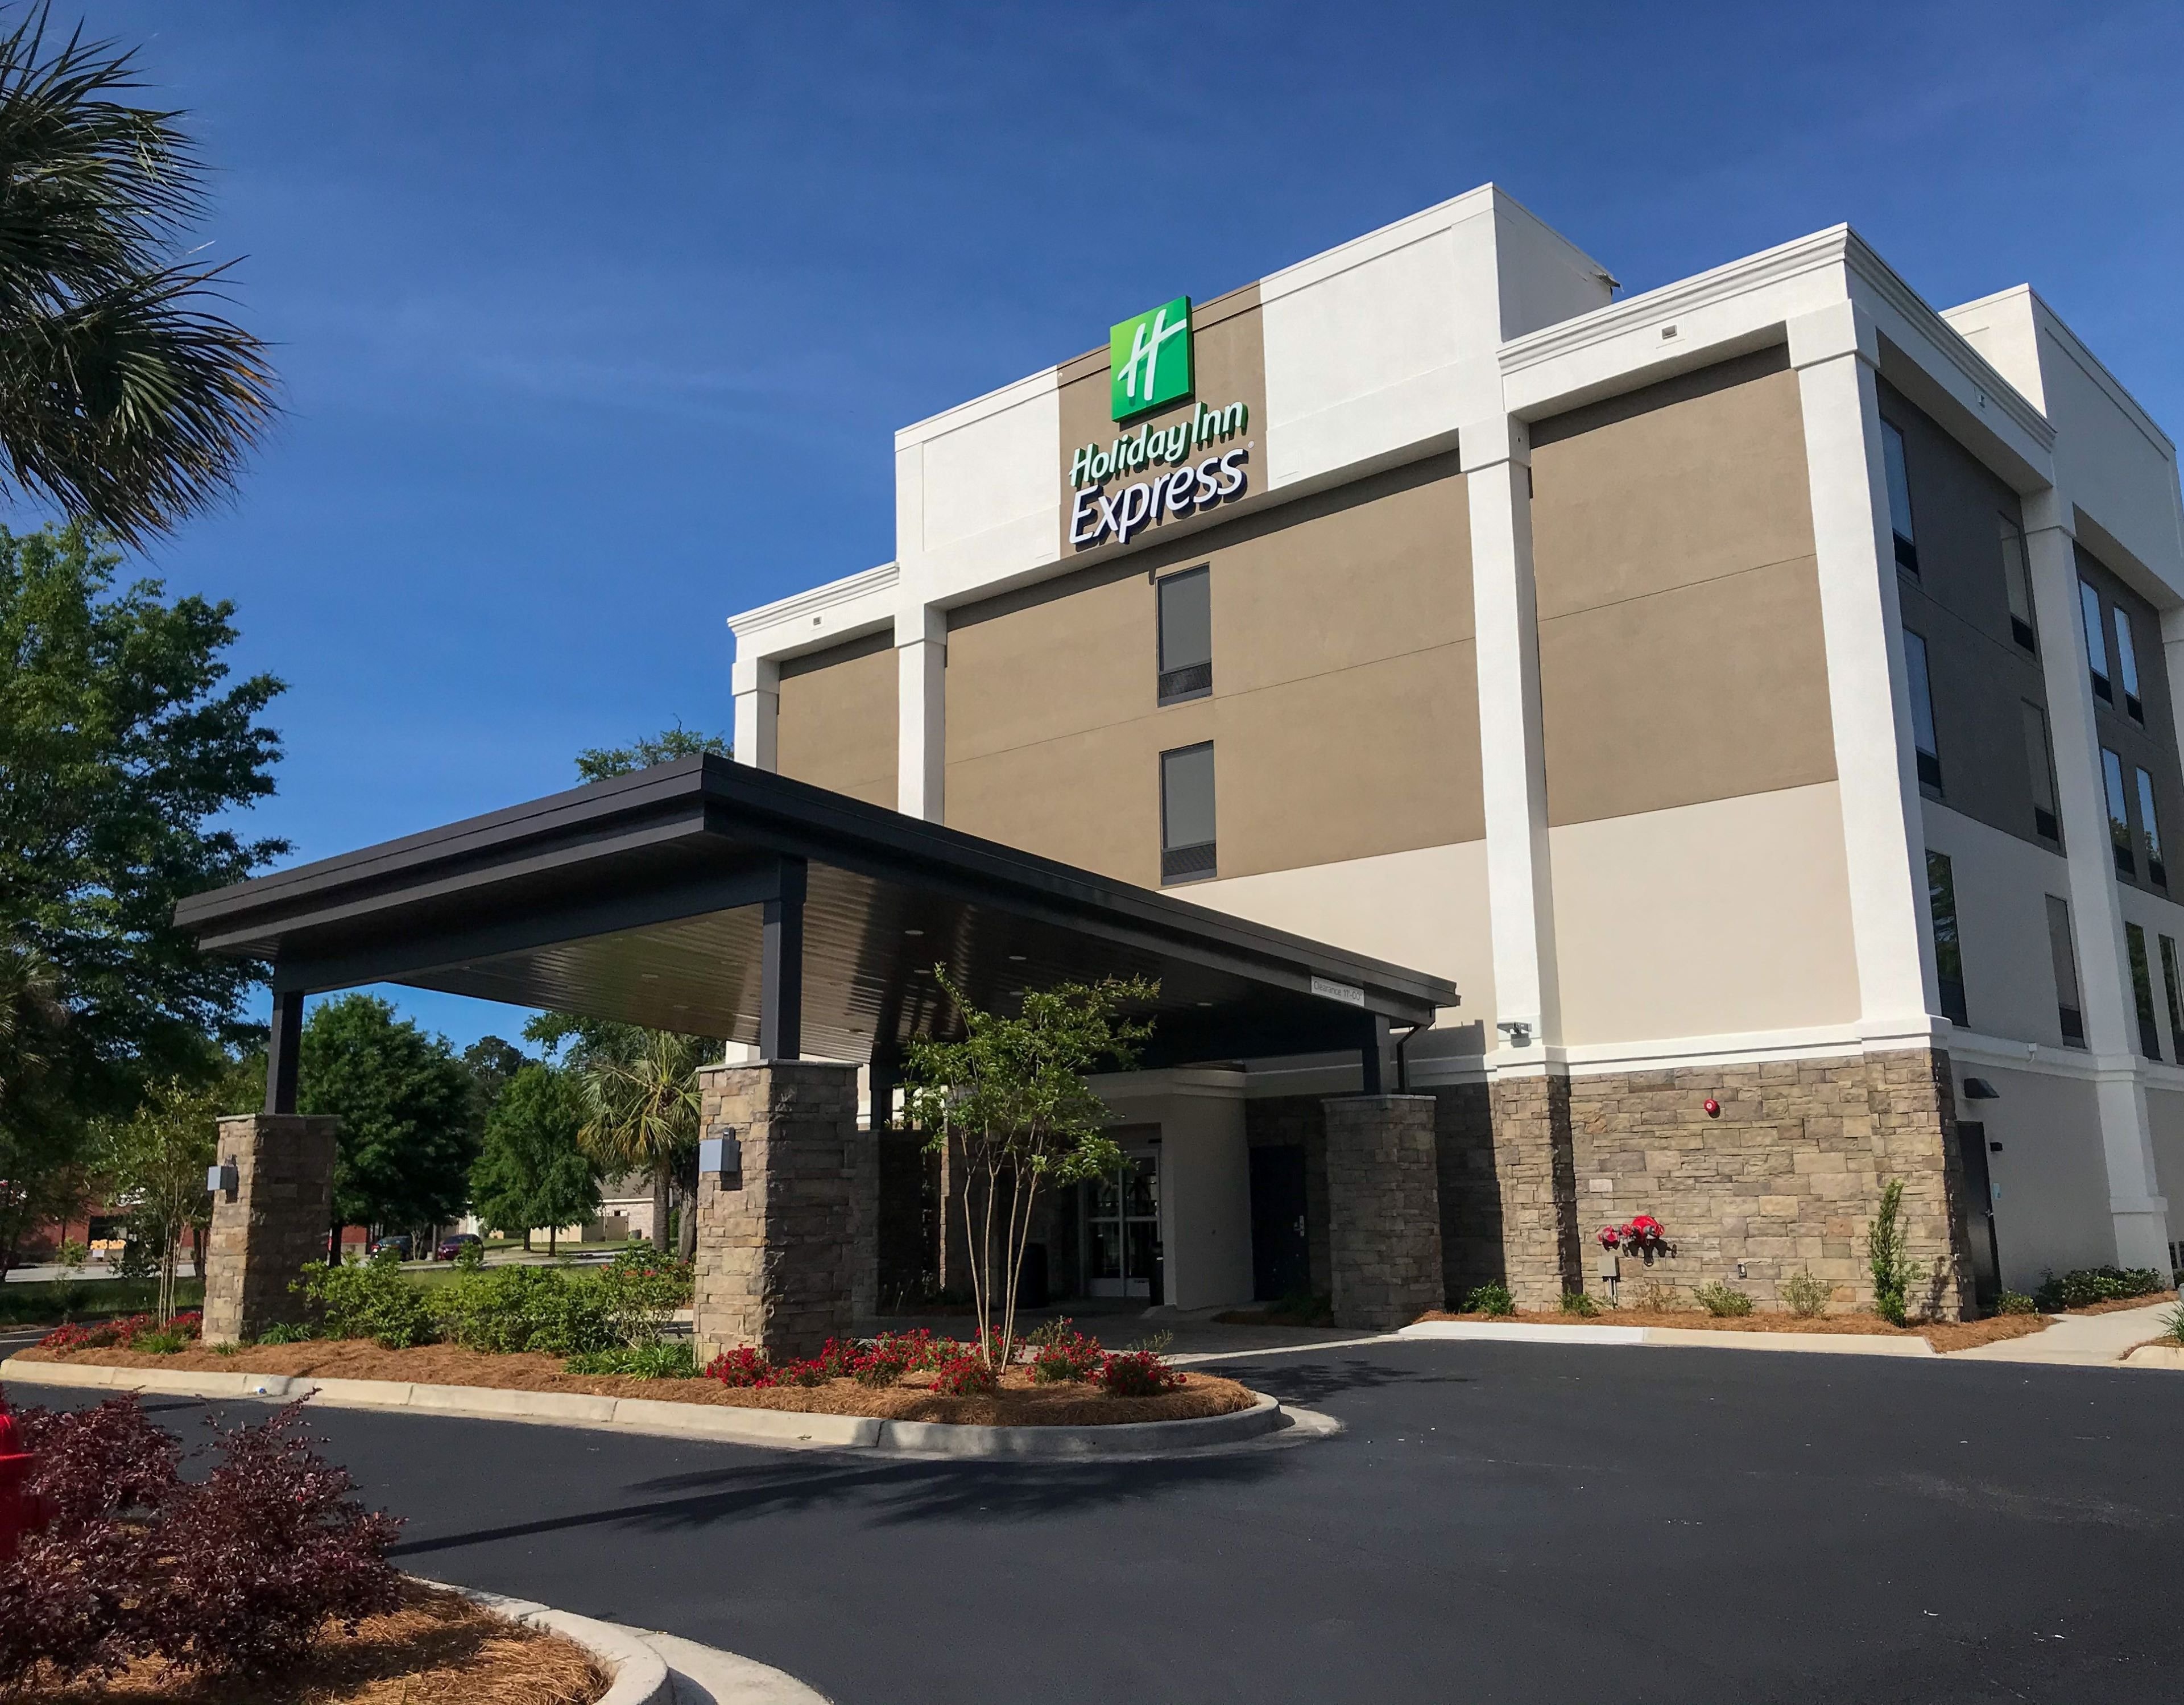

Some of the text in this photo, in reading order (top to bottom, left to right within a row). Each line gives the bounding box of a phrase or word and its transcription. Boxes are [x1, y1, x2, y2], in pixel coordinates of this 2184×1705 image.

[1069, 401, 1244, 487] Holiday Inn
[1069, 448, 1244, 544] Express
